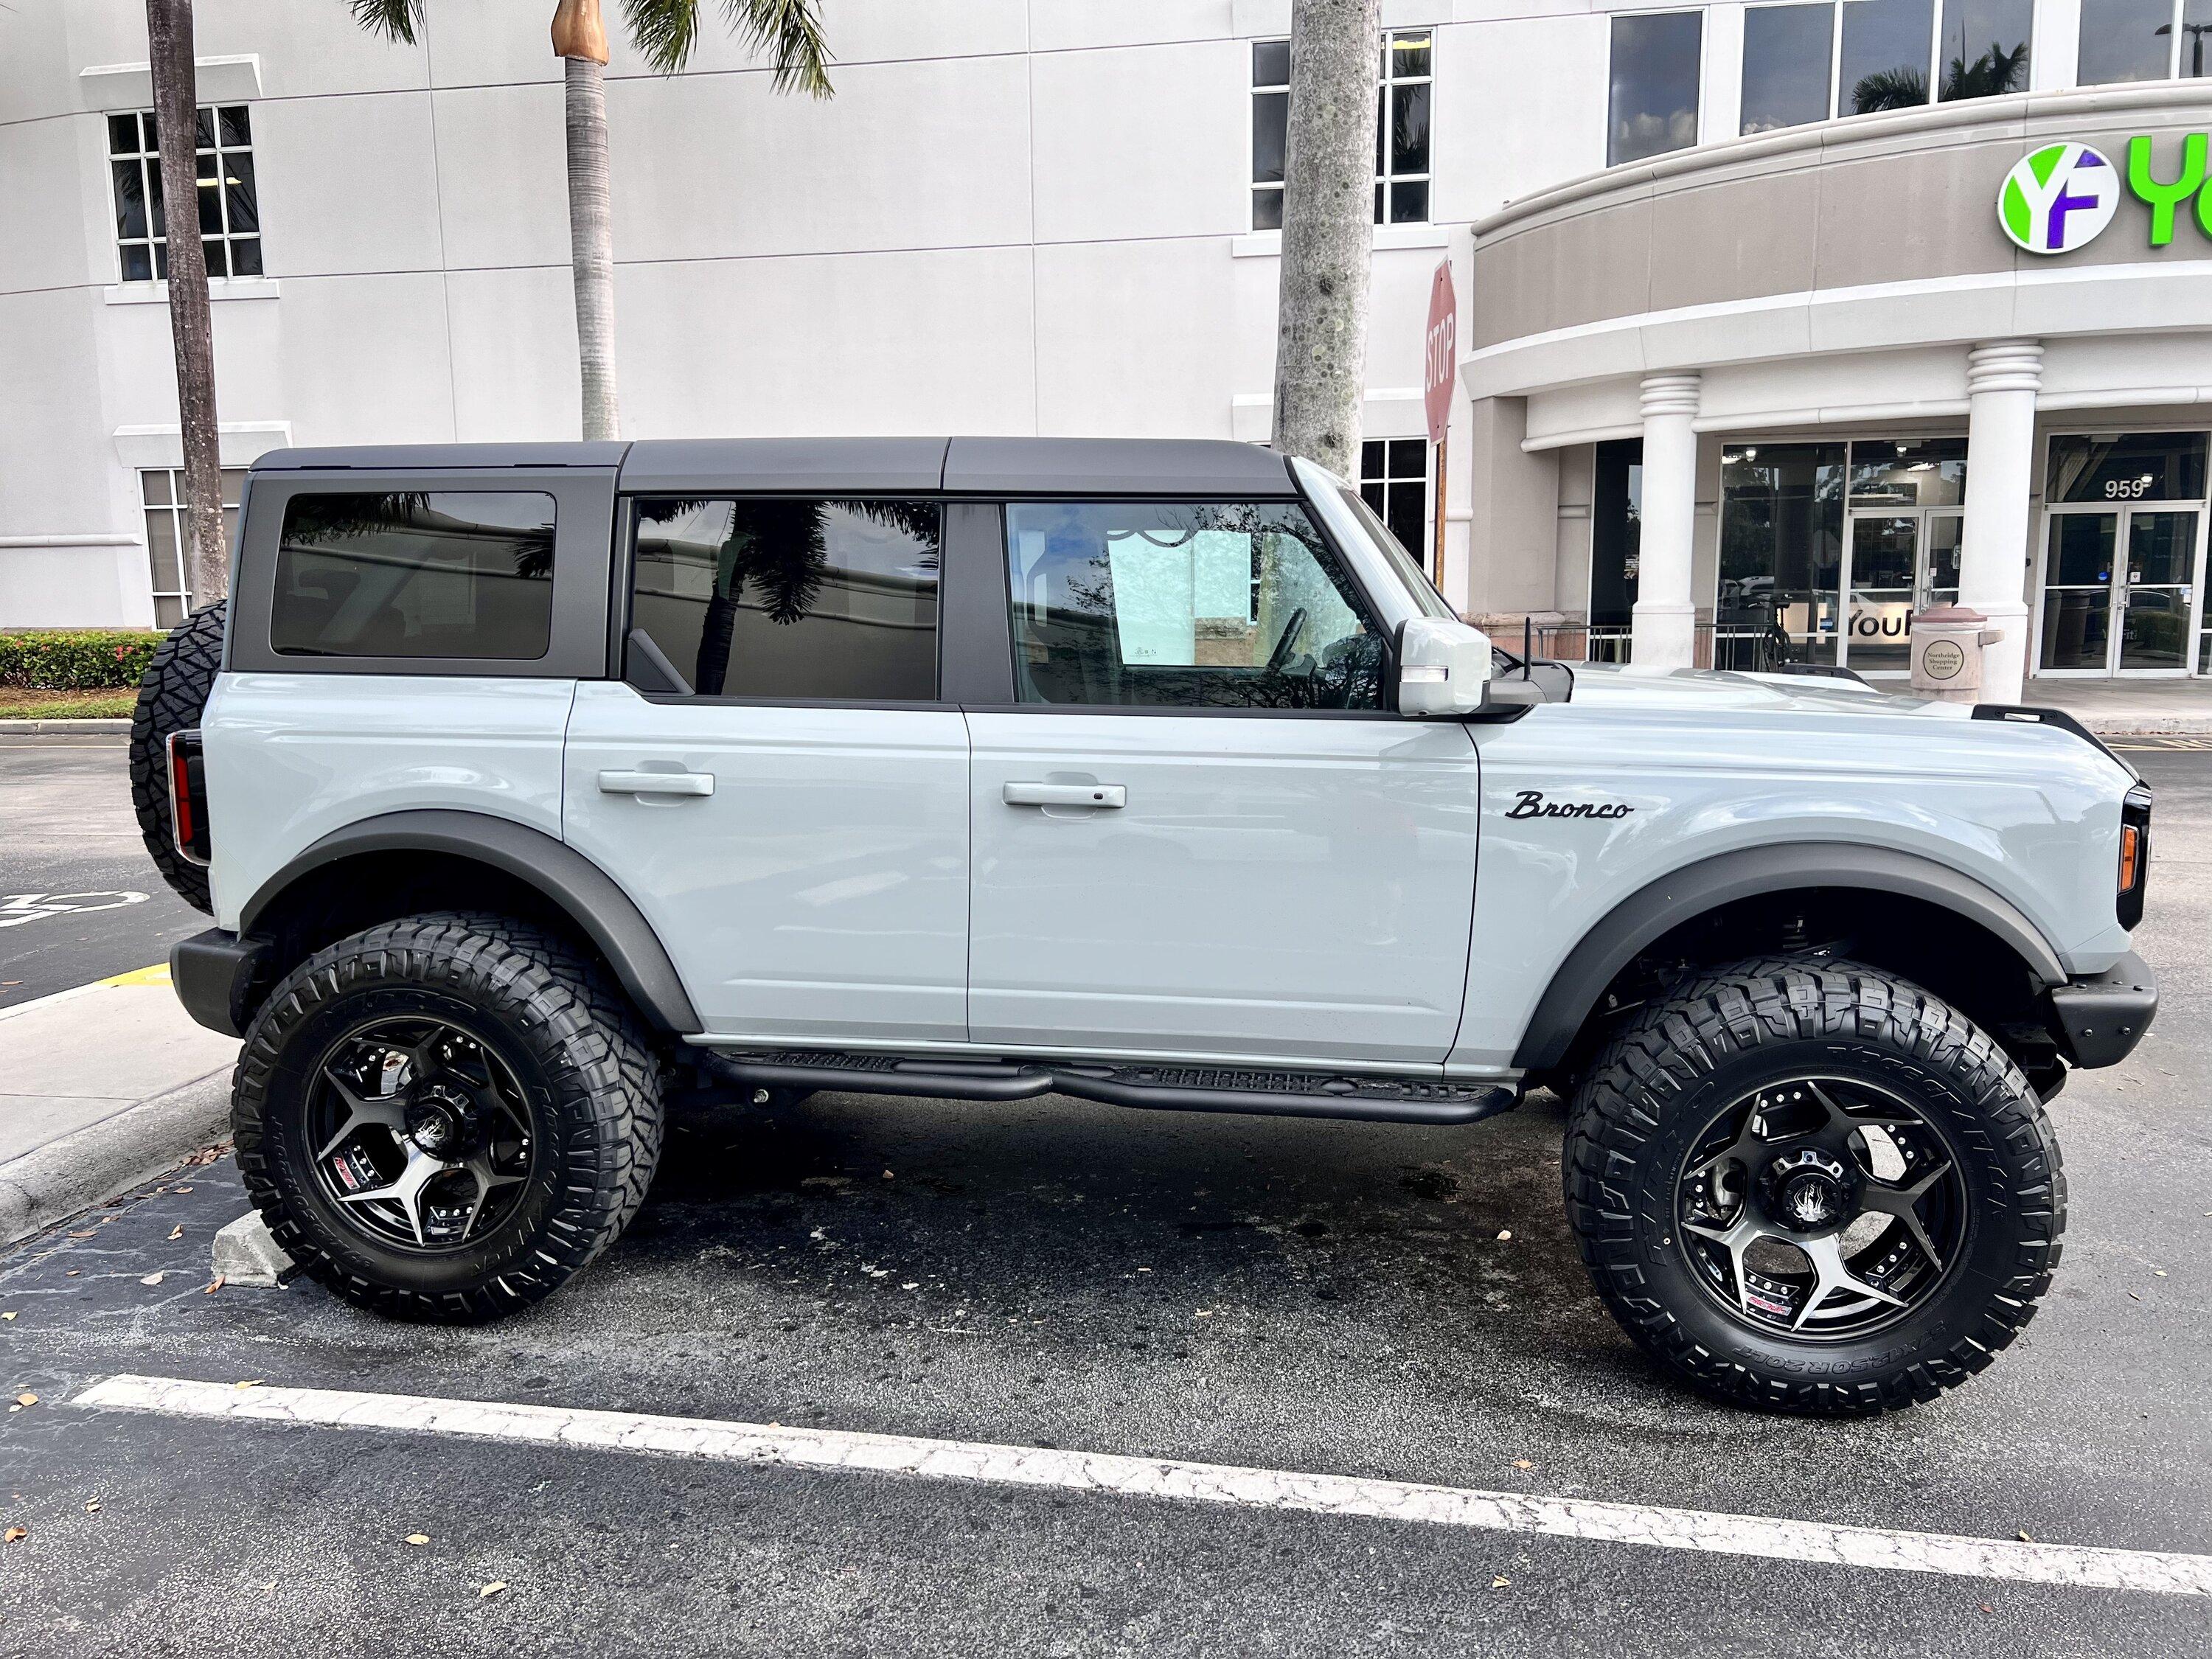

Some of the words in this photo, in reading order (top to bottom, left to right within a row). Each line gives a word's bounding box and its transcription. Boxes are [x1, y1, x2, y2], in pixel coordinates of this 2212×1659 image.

[2126, 133, 2212, 247] Y
[1426, 313, 1454, 392] STOP
[2105, 480, 2144, 498] 959
[1504, 790, 1635, 820] Bronco
